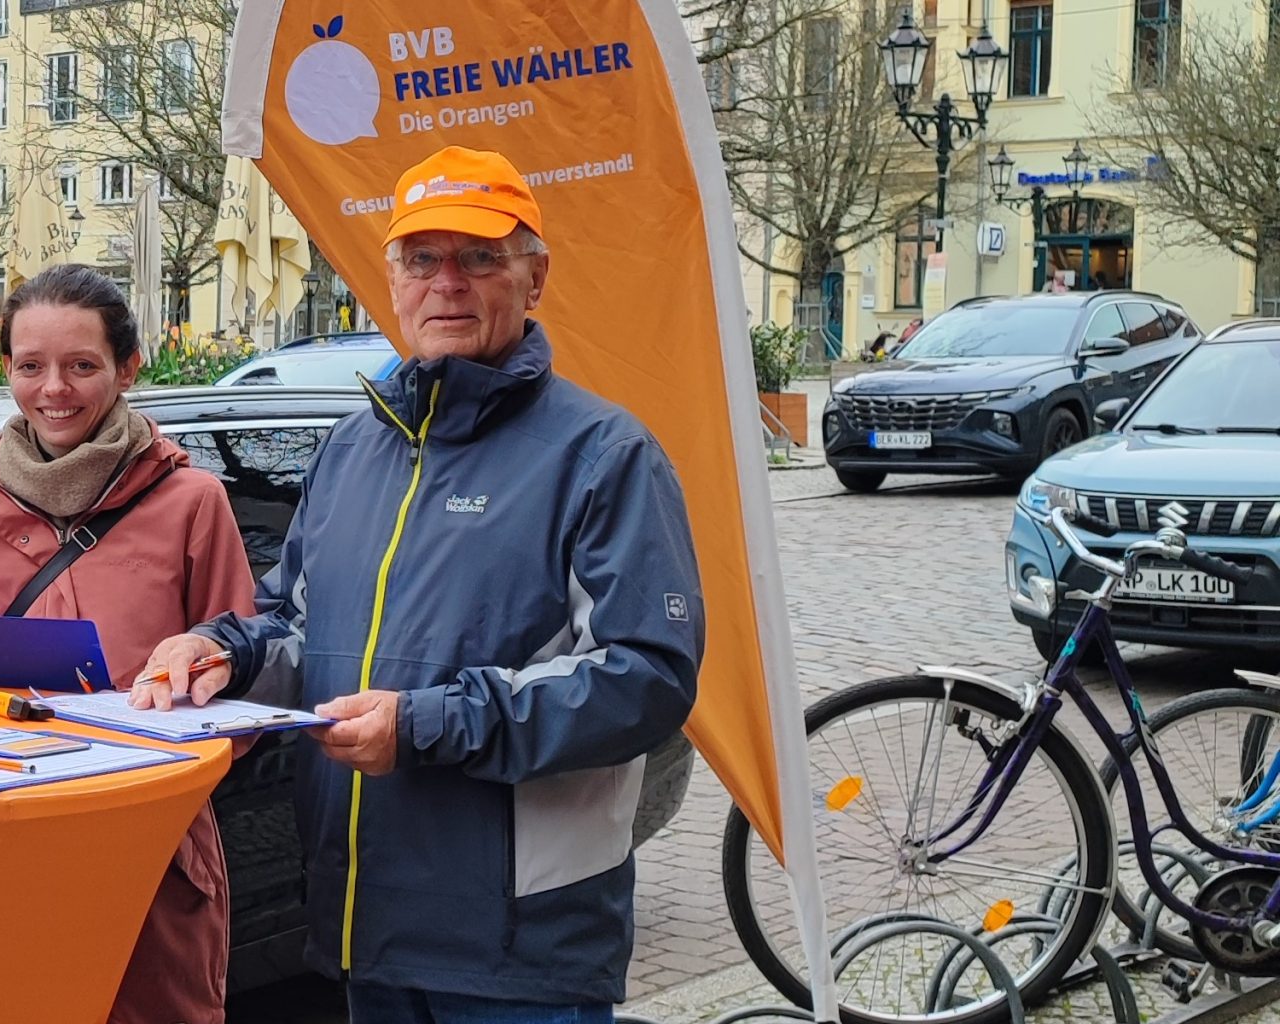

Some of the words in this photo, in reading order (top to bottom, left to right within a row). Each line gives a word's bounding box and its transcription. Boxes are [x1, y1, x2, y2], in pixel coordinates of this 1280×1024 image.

[389, 27, 455, 61] BVB
[394, 63, 482, 101] FREIE
[492, 42, 633, 87] WÄHLER
[399, 112, 434, 134] Die
[438, 100, 535, 128] Orangen
[520, 154, 634, 188] enverstand!
[1158, 573, 1184, 592] LK
[1190, 575, 1230, 594] 100
